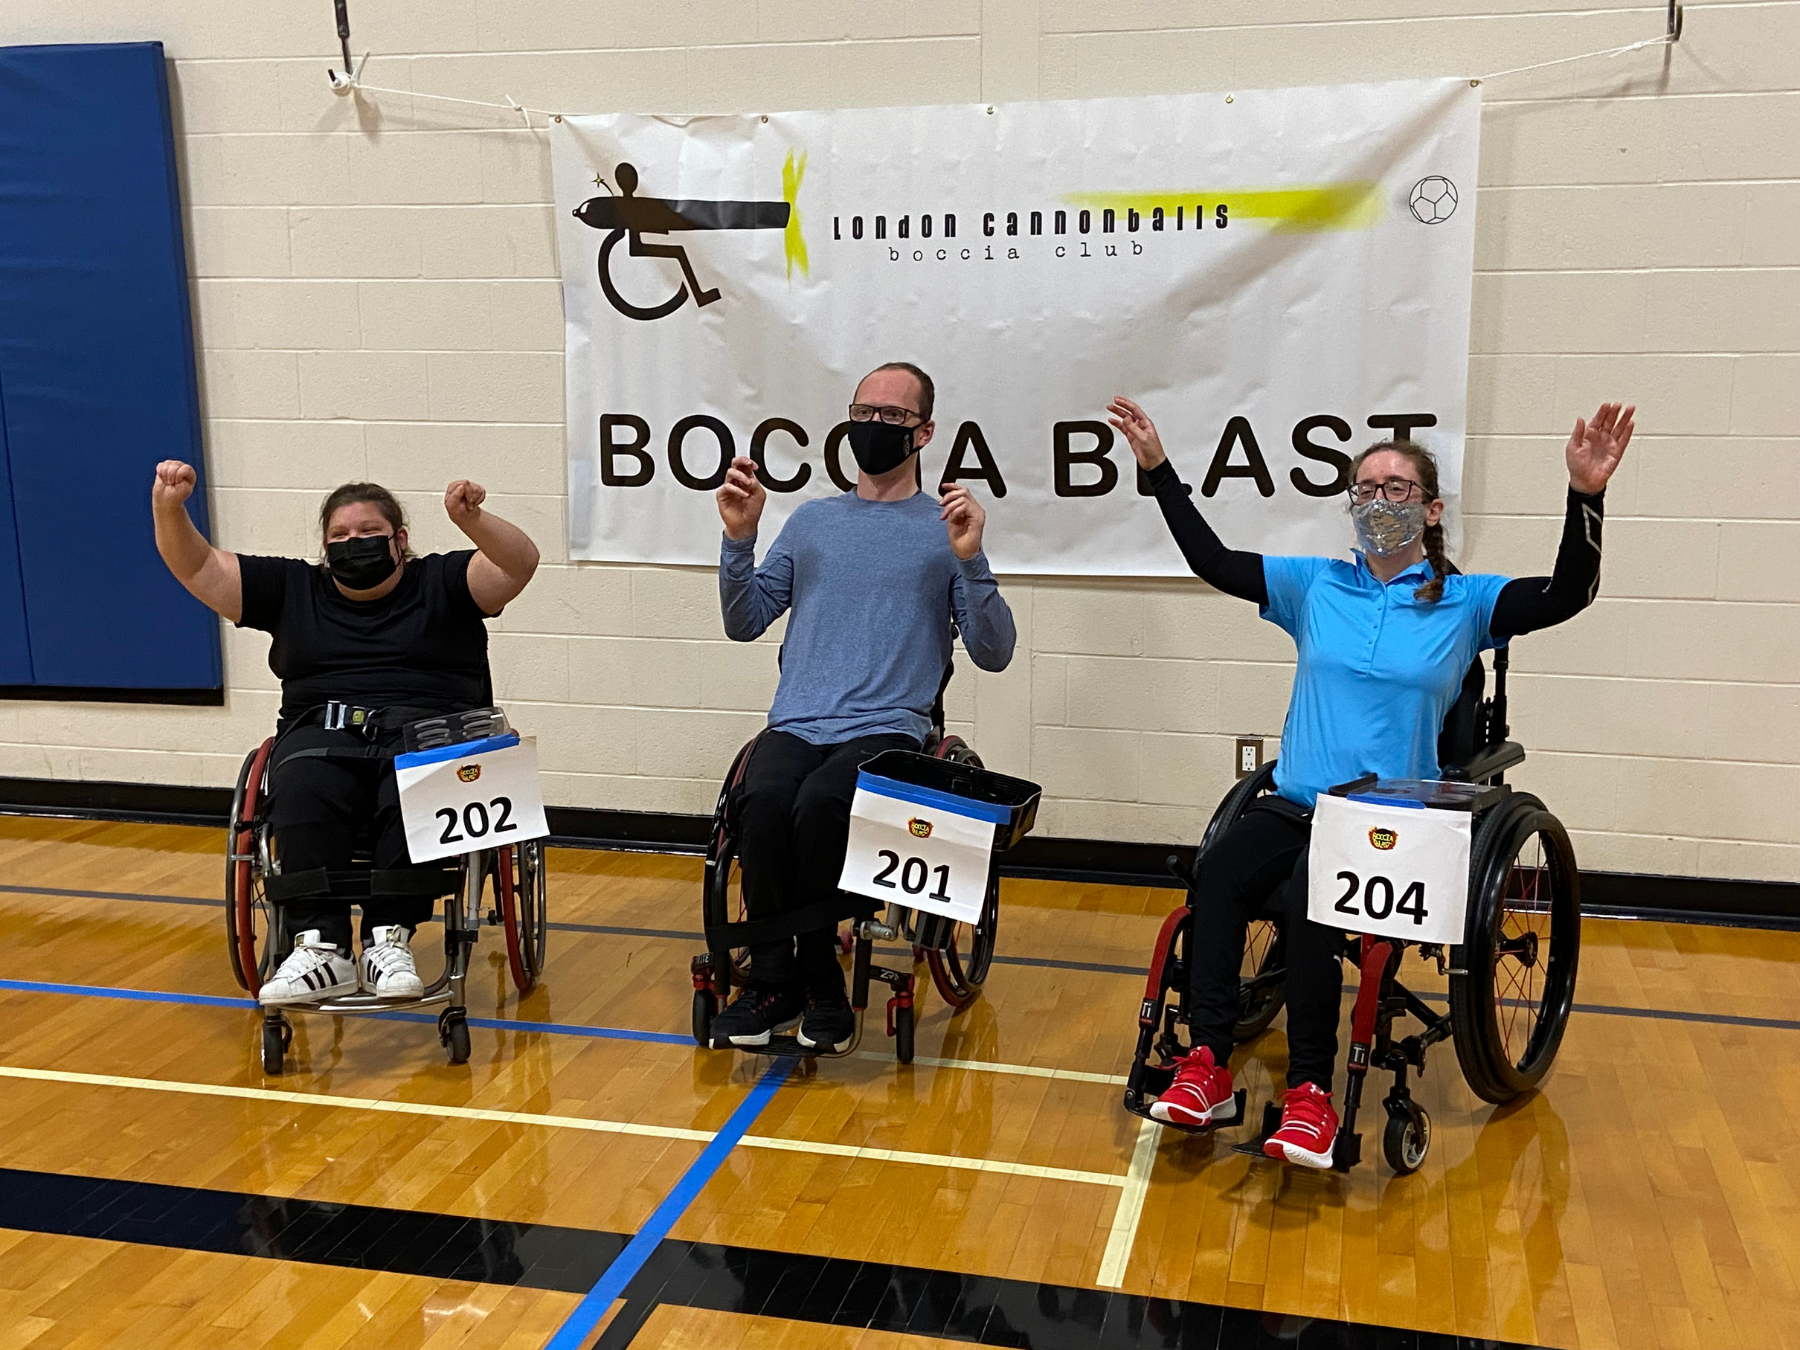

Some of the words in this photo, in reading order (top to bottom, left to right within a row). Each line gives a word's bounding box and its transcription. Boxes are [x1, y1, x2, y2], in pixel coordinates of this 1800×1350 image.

[888, 246, 1020, 262] boccia
[1055, 240, 1143, 258] club
[599, 413, 1008, 499] BOCCA
[435, 796, 518, 845] 202
[872, 849, 951, 903] 201
[1334, 870, 1429, 926] 204
[1141, 1002, 1152, 1018] Ti
[1353, 1046, 1366, 1064] Ti
